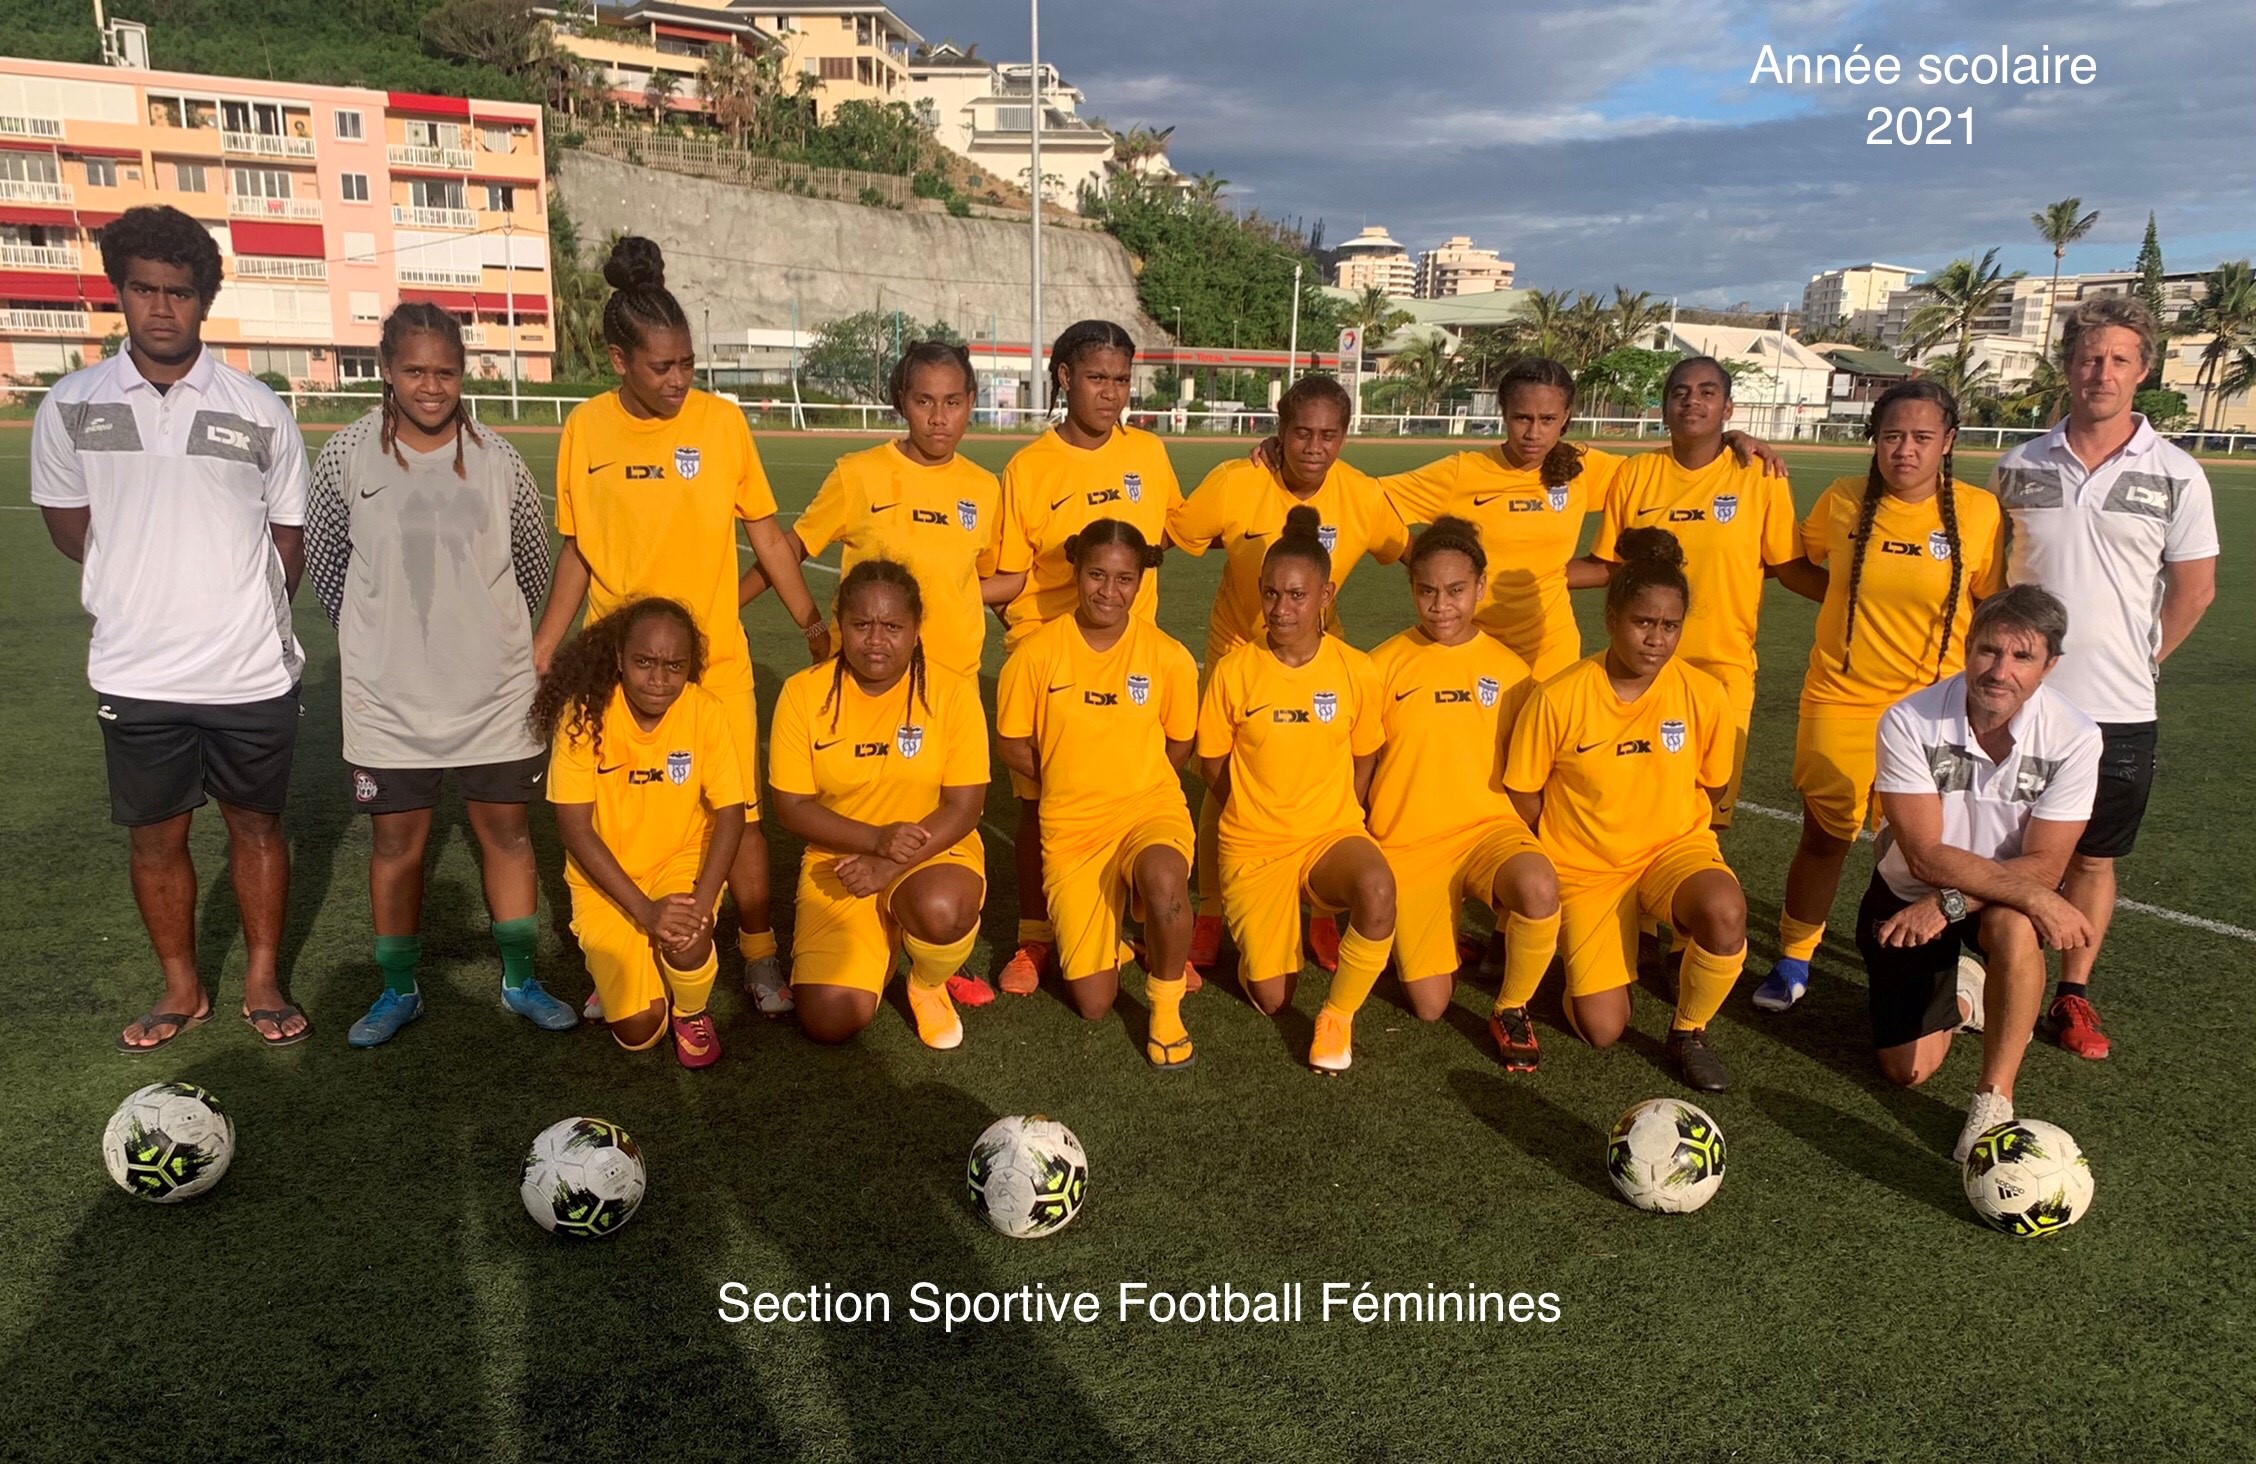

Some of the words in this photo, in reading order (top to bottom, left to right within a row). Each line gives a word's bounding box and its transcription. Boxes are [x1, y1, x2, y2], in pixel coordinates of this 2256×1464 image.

[207, 425, 250, 450] LDK
[625, 465, 665, 480] LDK
[1086, 488, 1122, 506] LDK
[2126, 486, 2168, 511] LDK
[1508, 499, 1544, 513] LDK
[912, 509, 949, 526] LDK
[1668, 508, 1706, 522] LDK
[1881, 540, 1923, 557] LDK
[1084, 690, 1118, 706] LDK
[1434, 689, 1472, 704] LDK
[1273, 709, 1310, 723] LDK
[854, 742, 890, 758] LDK
[1616, 739, 1653, 757] LDK
[628, 768, 665, 785] LDK
[1995, 1178, 2025, 1194] adidas
